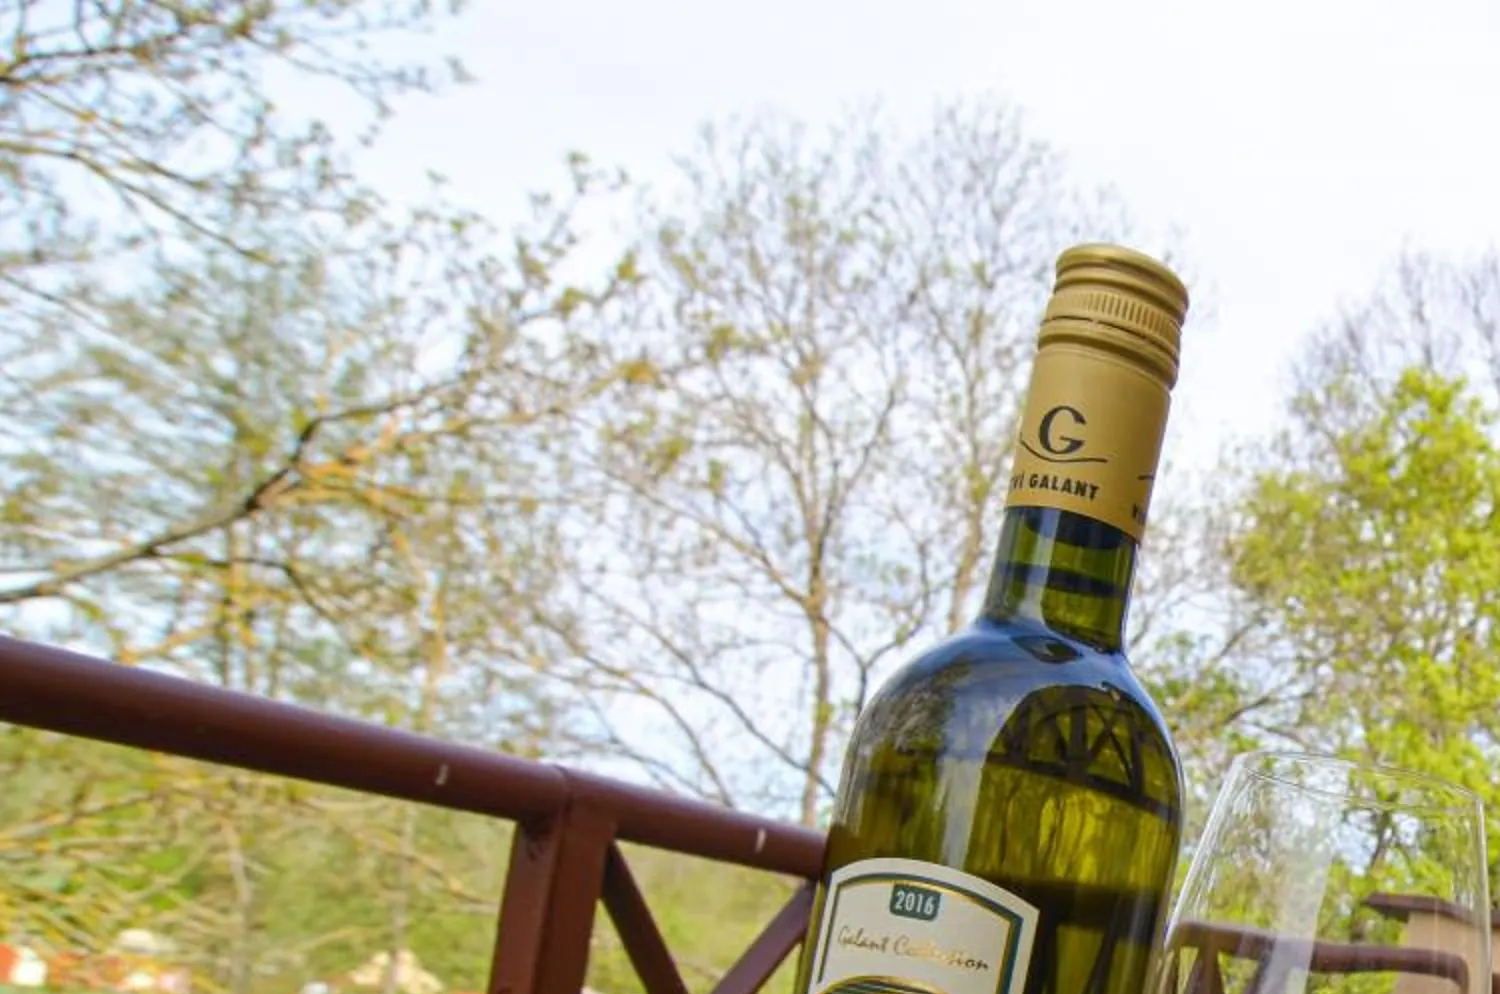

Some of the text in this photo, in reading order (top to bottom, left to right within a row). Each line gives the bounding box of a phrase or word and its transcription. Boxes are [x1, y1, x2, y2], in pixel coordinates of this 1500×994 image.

[1039, 405, 1087, 455] G
[1029, 473, 1100, 500] GALANT
[894, 890, 936, 916] 2016
